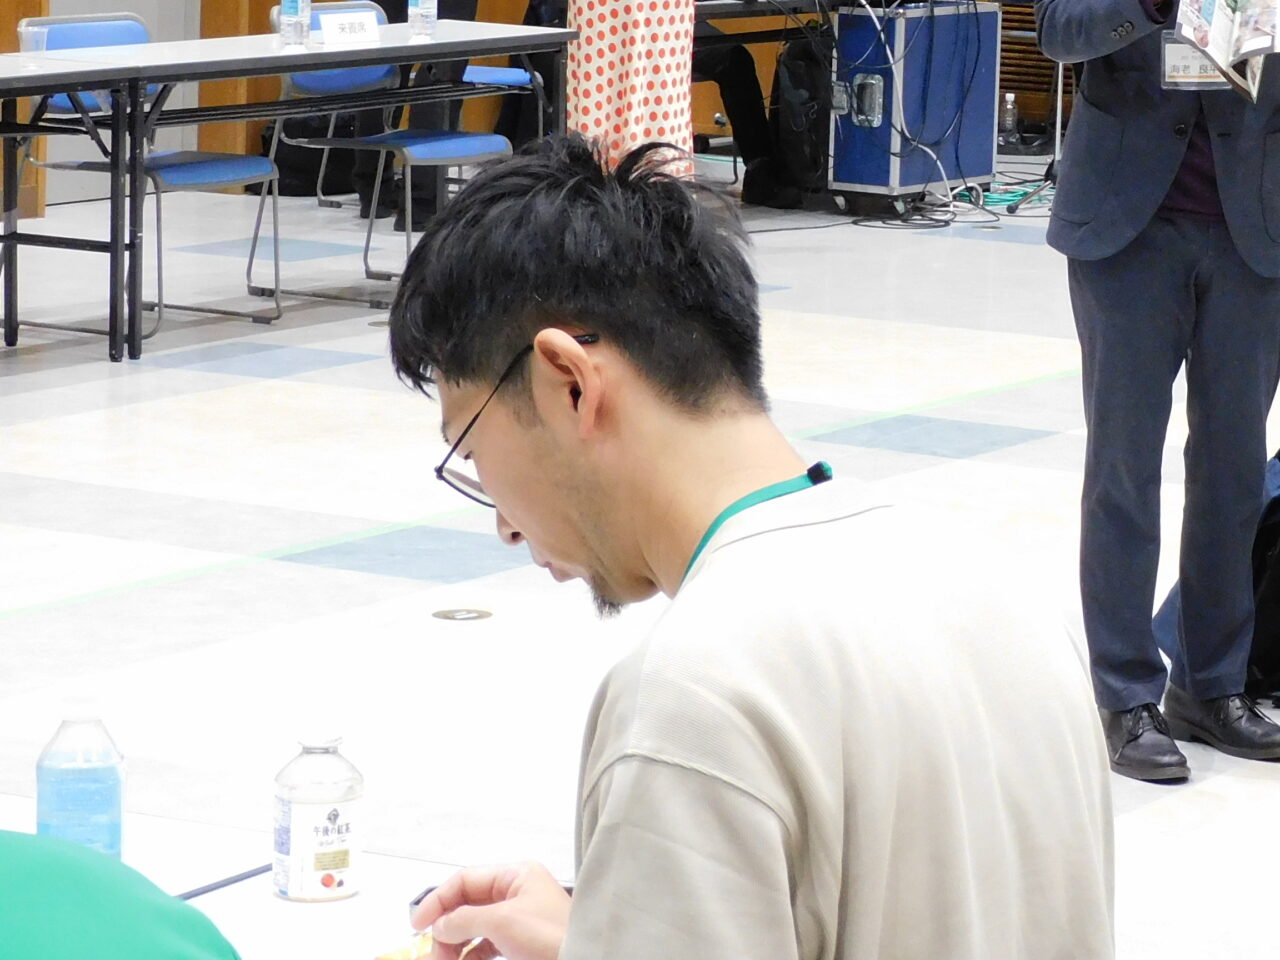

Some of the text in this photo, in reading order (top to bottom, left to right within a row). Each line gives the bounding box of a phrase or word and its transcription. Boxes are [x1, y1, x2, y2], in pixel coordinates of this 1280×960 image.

[313, 823, 352, 837] 午後の紅茶
